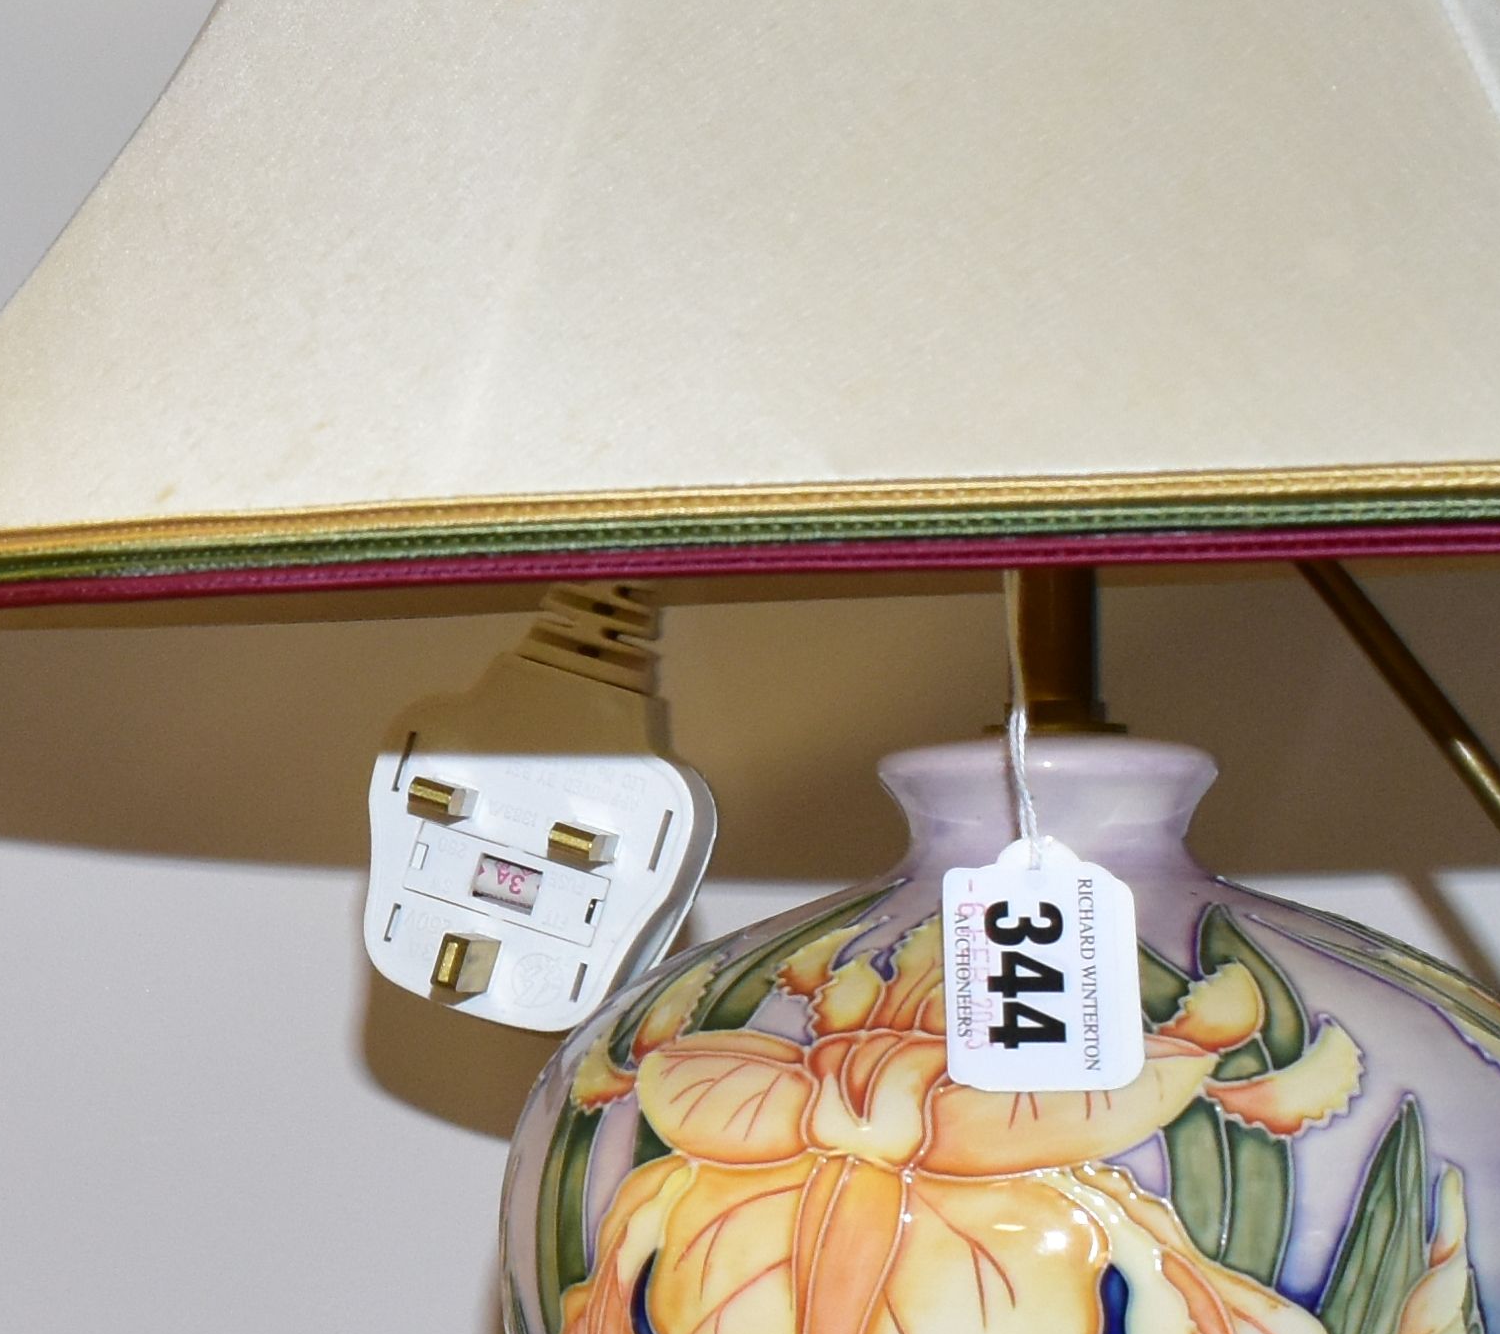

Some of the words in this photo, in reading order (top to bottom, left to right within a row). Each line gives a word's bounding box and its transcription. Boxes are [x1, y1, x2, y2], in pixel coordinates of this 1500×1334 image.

[492, 868, 527, 896] 3A
[1077, 878, 1095, 960] RICHARD
[954, 912, 972, 1038] AUCTIONEERS
[984, 900, 1066, 1049] 344
[1080, 964, 1101, 1071] WINTERTON
